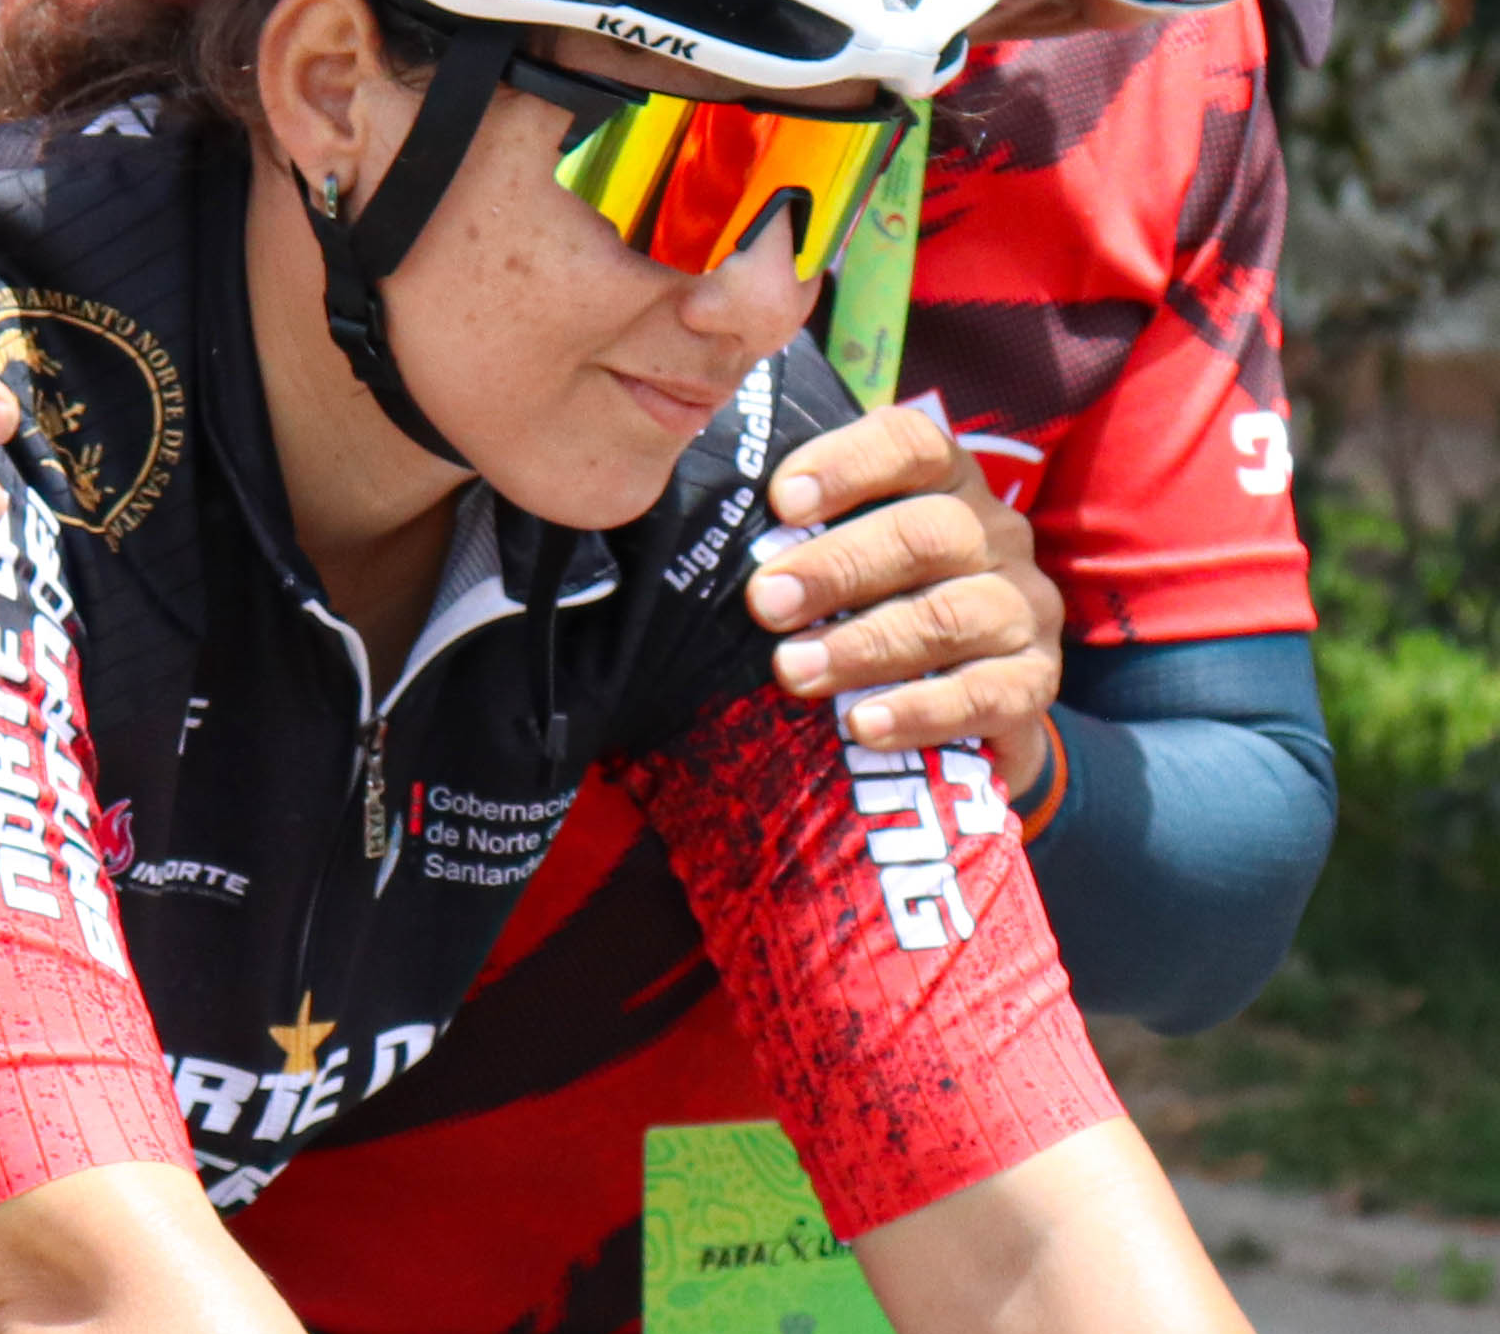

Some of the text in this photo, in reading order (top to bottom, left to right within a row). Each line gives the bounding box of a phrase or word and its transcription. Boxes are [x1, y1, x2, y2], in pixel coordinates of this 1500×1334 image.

[595, 12, 700, 61] KASK
[133, 330, 187, 421] NORTE
[159, 428, 185, 466] DE
[663, 526, 731, 593] Liga
[719, 486, 756, 528] de
[425, 820, 460, 846] de
[466, 827, 542, 855] Norte
